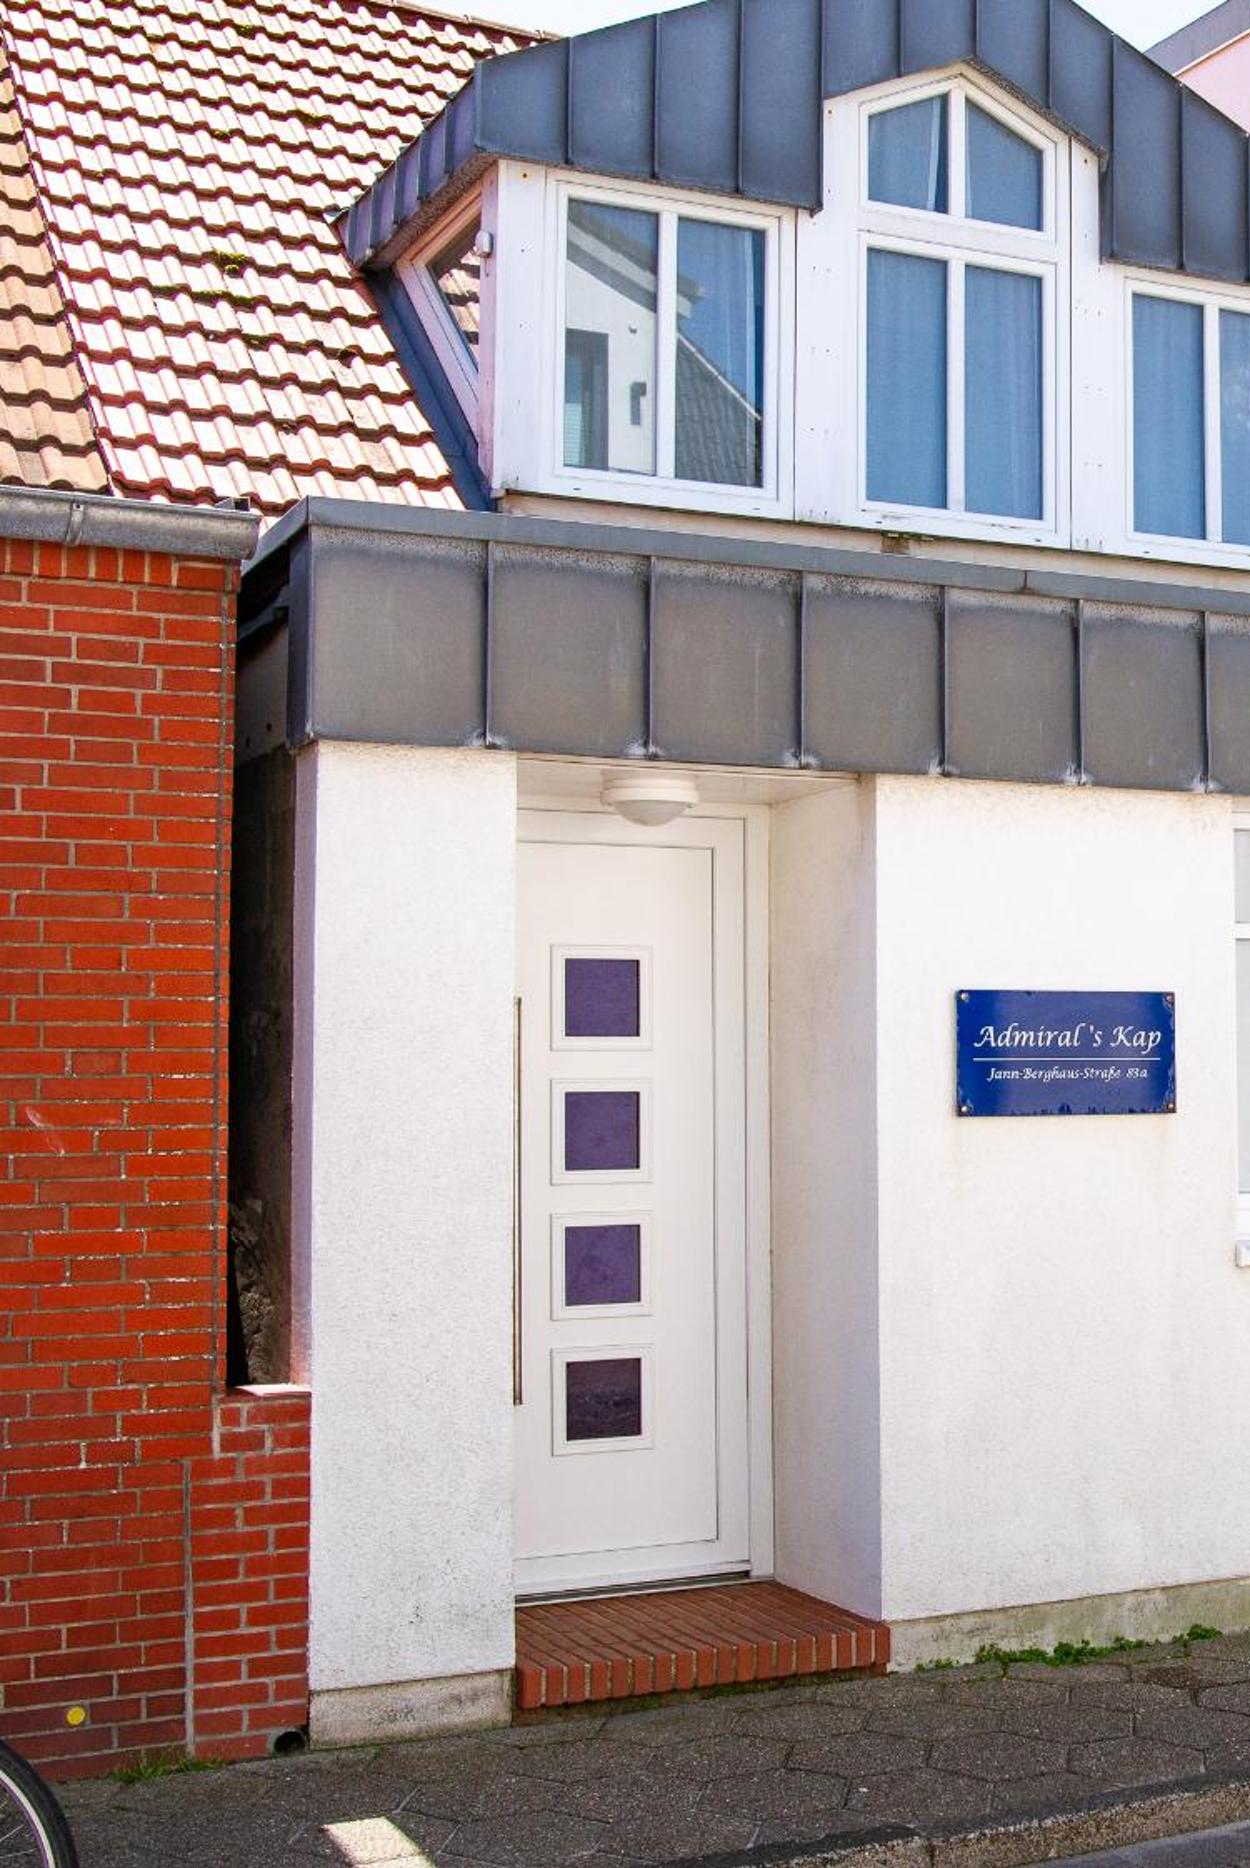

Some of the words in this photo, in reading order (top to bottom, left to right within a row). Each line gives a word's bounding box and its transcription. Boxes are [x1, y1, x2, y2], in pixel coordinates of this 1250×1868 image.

[1109, 1025, 1162, 1054] Kap
[986, 1065, 1121, 1083] Jann-Berghaus-Straße
[1126, 1067, 1148, 1079] 83a
